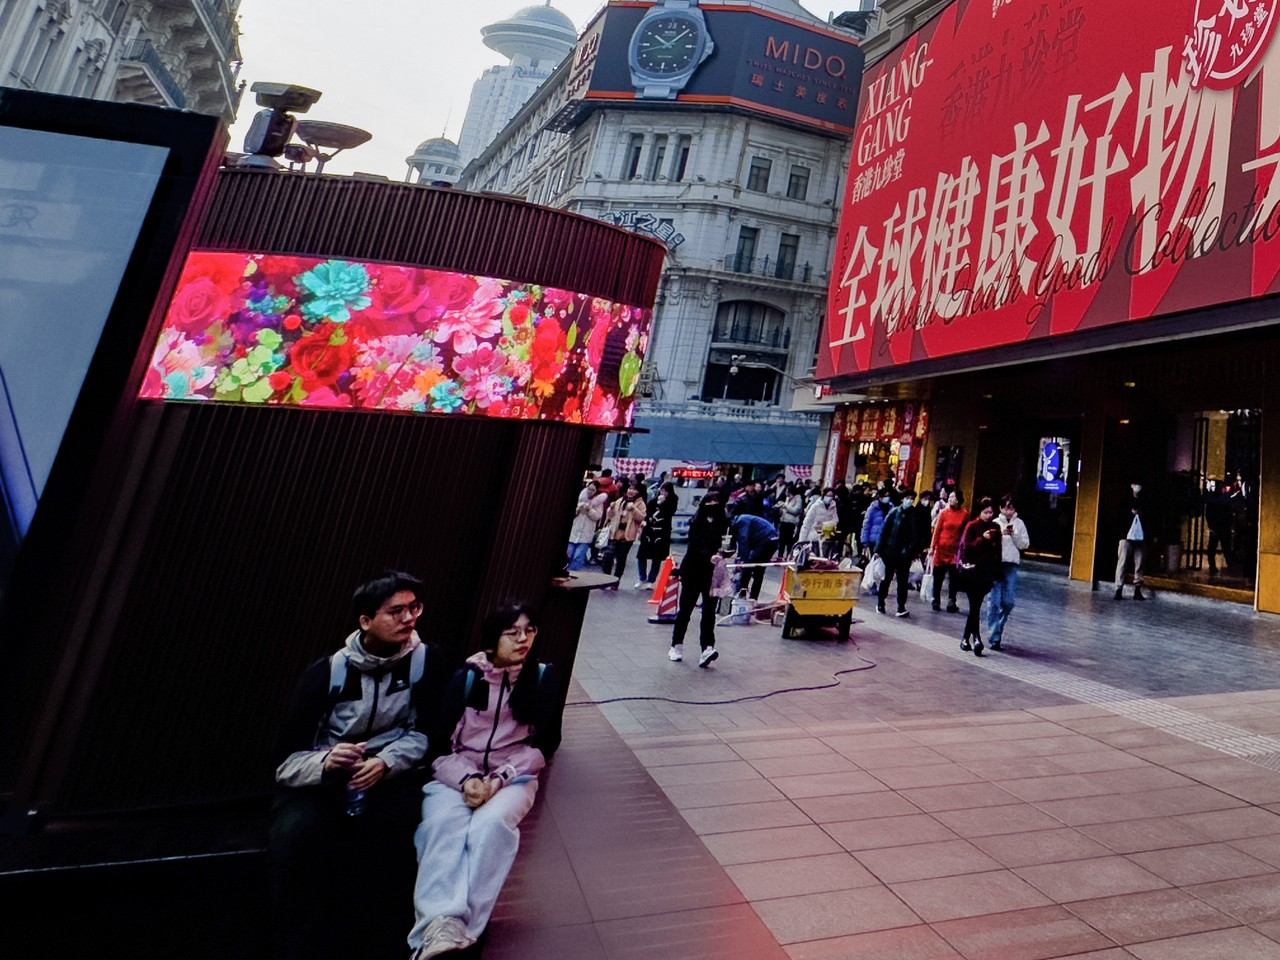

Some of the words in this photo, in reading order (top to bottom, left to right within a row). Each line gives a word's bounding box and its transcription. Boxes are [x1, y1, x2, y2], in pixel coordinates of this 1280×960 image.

[766, 35, 846, 78] MIDO
[1229, 2, 1270, 67] 九珍堂
[862, 42, 934, 124] XIANG-
[857, 96, 912, 167] GANG
[851, 147, 906, 205] 香港九珍堂
[1026, 216, 1114, 325] Goods
